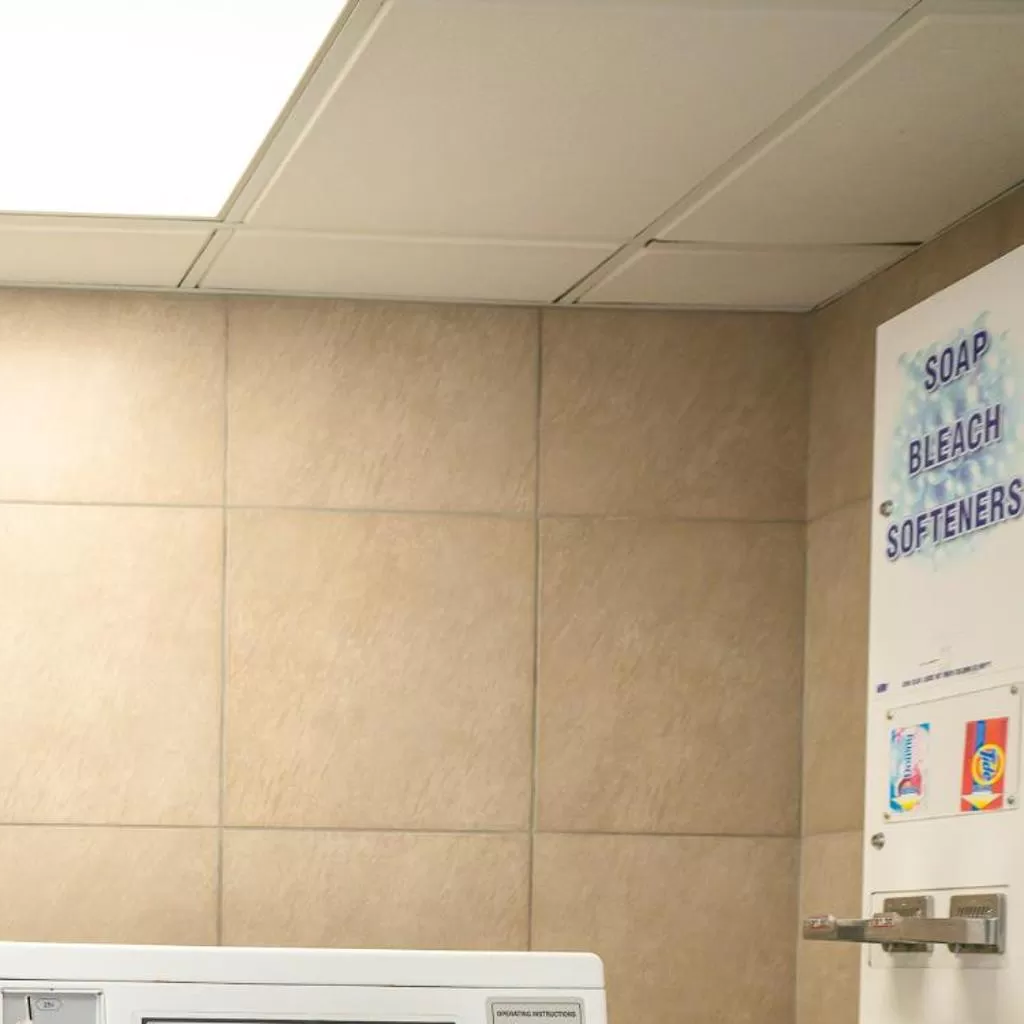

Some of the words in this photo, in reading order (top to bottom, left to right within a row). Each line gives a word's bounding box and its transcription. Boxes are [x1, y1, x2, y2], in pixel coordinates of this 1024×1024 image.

[925, 330, 988, 391] SOAP
[909, 403, 1002, 475] BLEACH
[886, 478, 1024, 558] SOFTENERS
[979, 748, 997, 782] Tide
